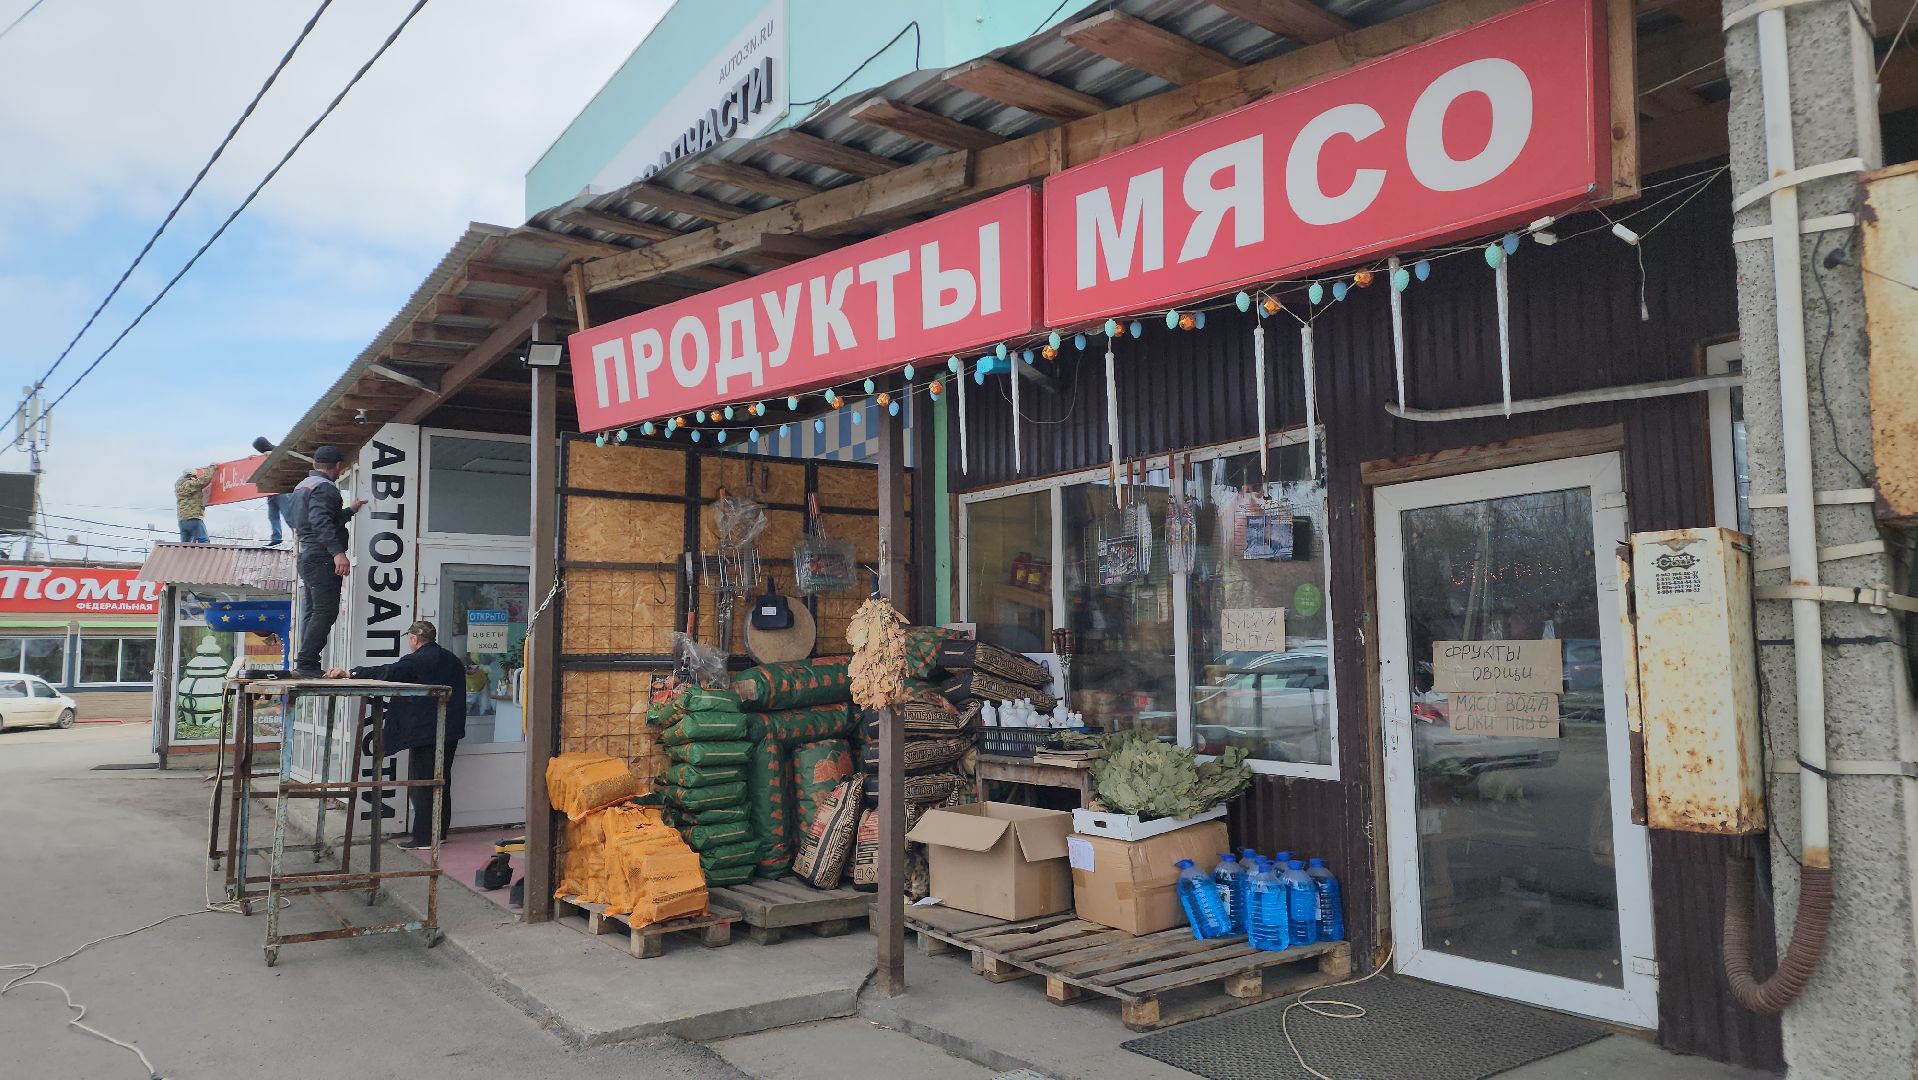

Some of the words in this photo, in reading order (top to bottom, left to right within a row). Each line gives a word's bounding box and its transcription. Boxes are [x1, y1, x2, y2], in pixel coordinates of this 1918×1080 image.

[1075, 57, 1533, 292] МЯСО
[592, 221, 1002, 408] ПРОДУКТЫ
[0, 568, 166, 601] Помп
[76, 602, 153, 611] ФЕДЕРАЛЬНАЯ
[469, 612, 506, 621] ОТКРЫТО
[472, 631, 504, 639] ЦВЕТЫ
[1445, 644, 1521, 662] ФРУКТЫ
[1472, 665, 1532, 682] ОВОЩИ
[1456, 694, 1497, 713] МЯСО
[1505, 694, 1549, 715] ВОДА
[1455, 714, 1495, 731] СОКИ
